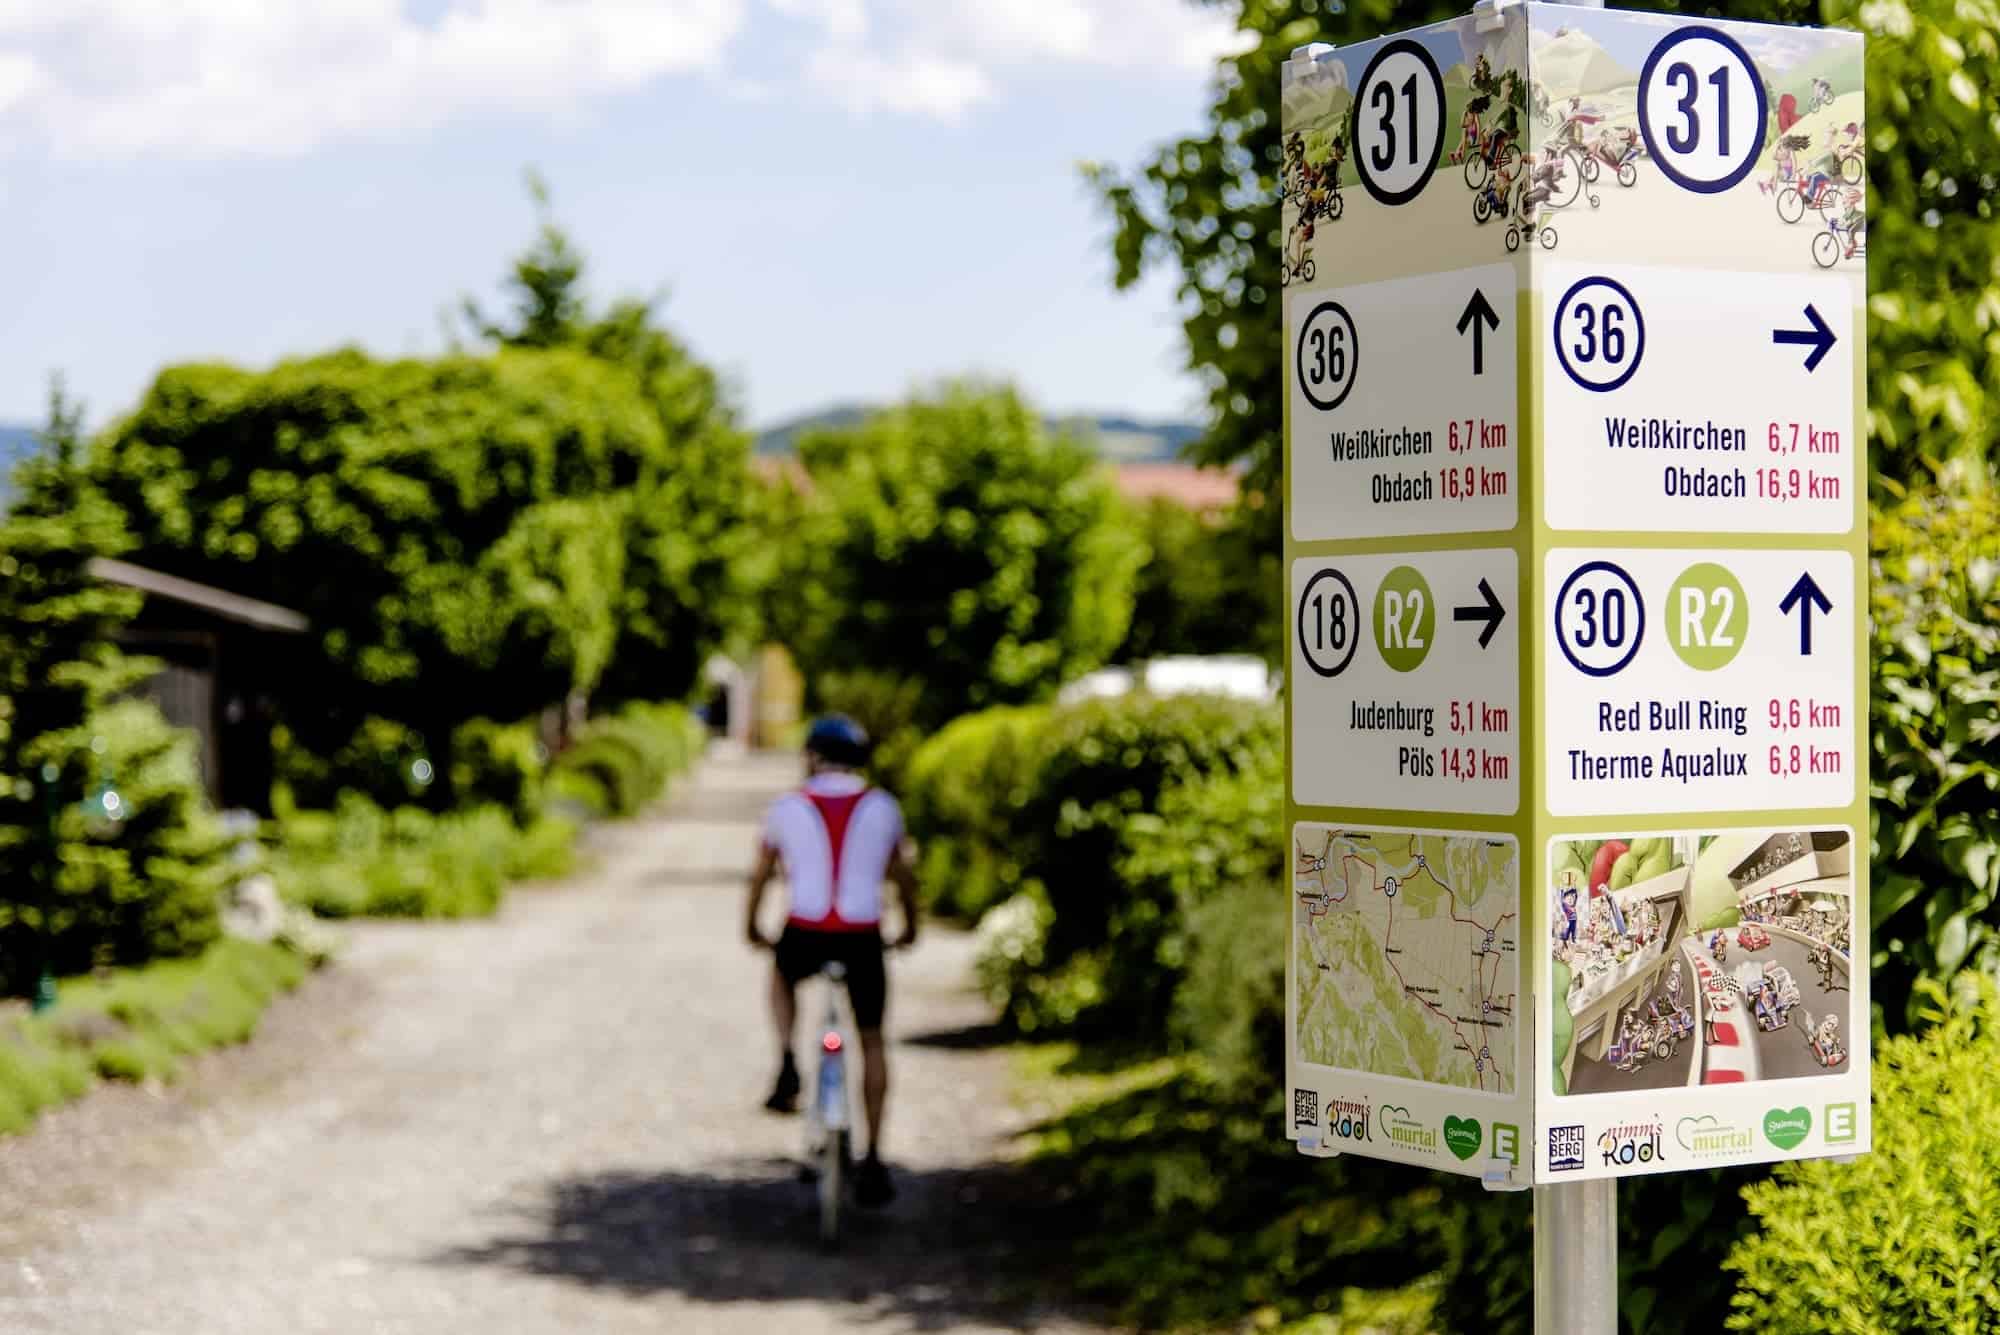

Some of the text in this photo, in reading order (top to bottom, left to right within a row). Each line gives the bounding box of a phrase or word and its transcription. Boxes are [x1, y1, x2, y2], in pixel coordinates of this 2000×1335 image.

[1371, 73, 1419, 172] 31
[1665, 61, 1730, 157] 31
[1573, 302, 1625, 364] 36
[1309, 325, 1345, 385] 36
[1331, 420, 1507, 462] Weißkirchen 6,7 km
[1606, 416, 1840, 458] Weißkirchen 6,7 km
[1371, 466, 1507, 504] Obdach 16,9 km
[1664, 465, 1840, 504] Obdach 16,9 km
[1312, 590, 1425, 650] 18 R2
[1574, 586, 1735, 648] 30 R2
[1350, 700, 1508, 736] Judenburg 5,1 km
[1599, 698, 1840, 736] Red Bull Ring 9,6 km
[1399, 747, 1508, 781] Pöls 14,3 km
[1569, 745, 1840, 784] Therme Aqualux 6,8 km
[1295, 1105, 1315, 1119] BERG
[1392, 1127, 1436, 1148] murtal
[1550, 1126, 1583, 1143] SPIEL
[1550, 1142, 1581, 1157] BERG
[1692, 1127, 1752, 1151] murtal
